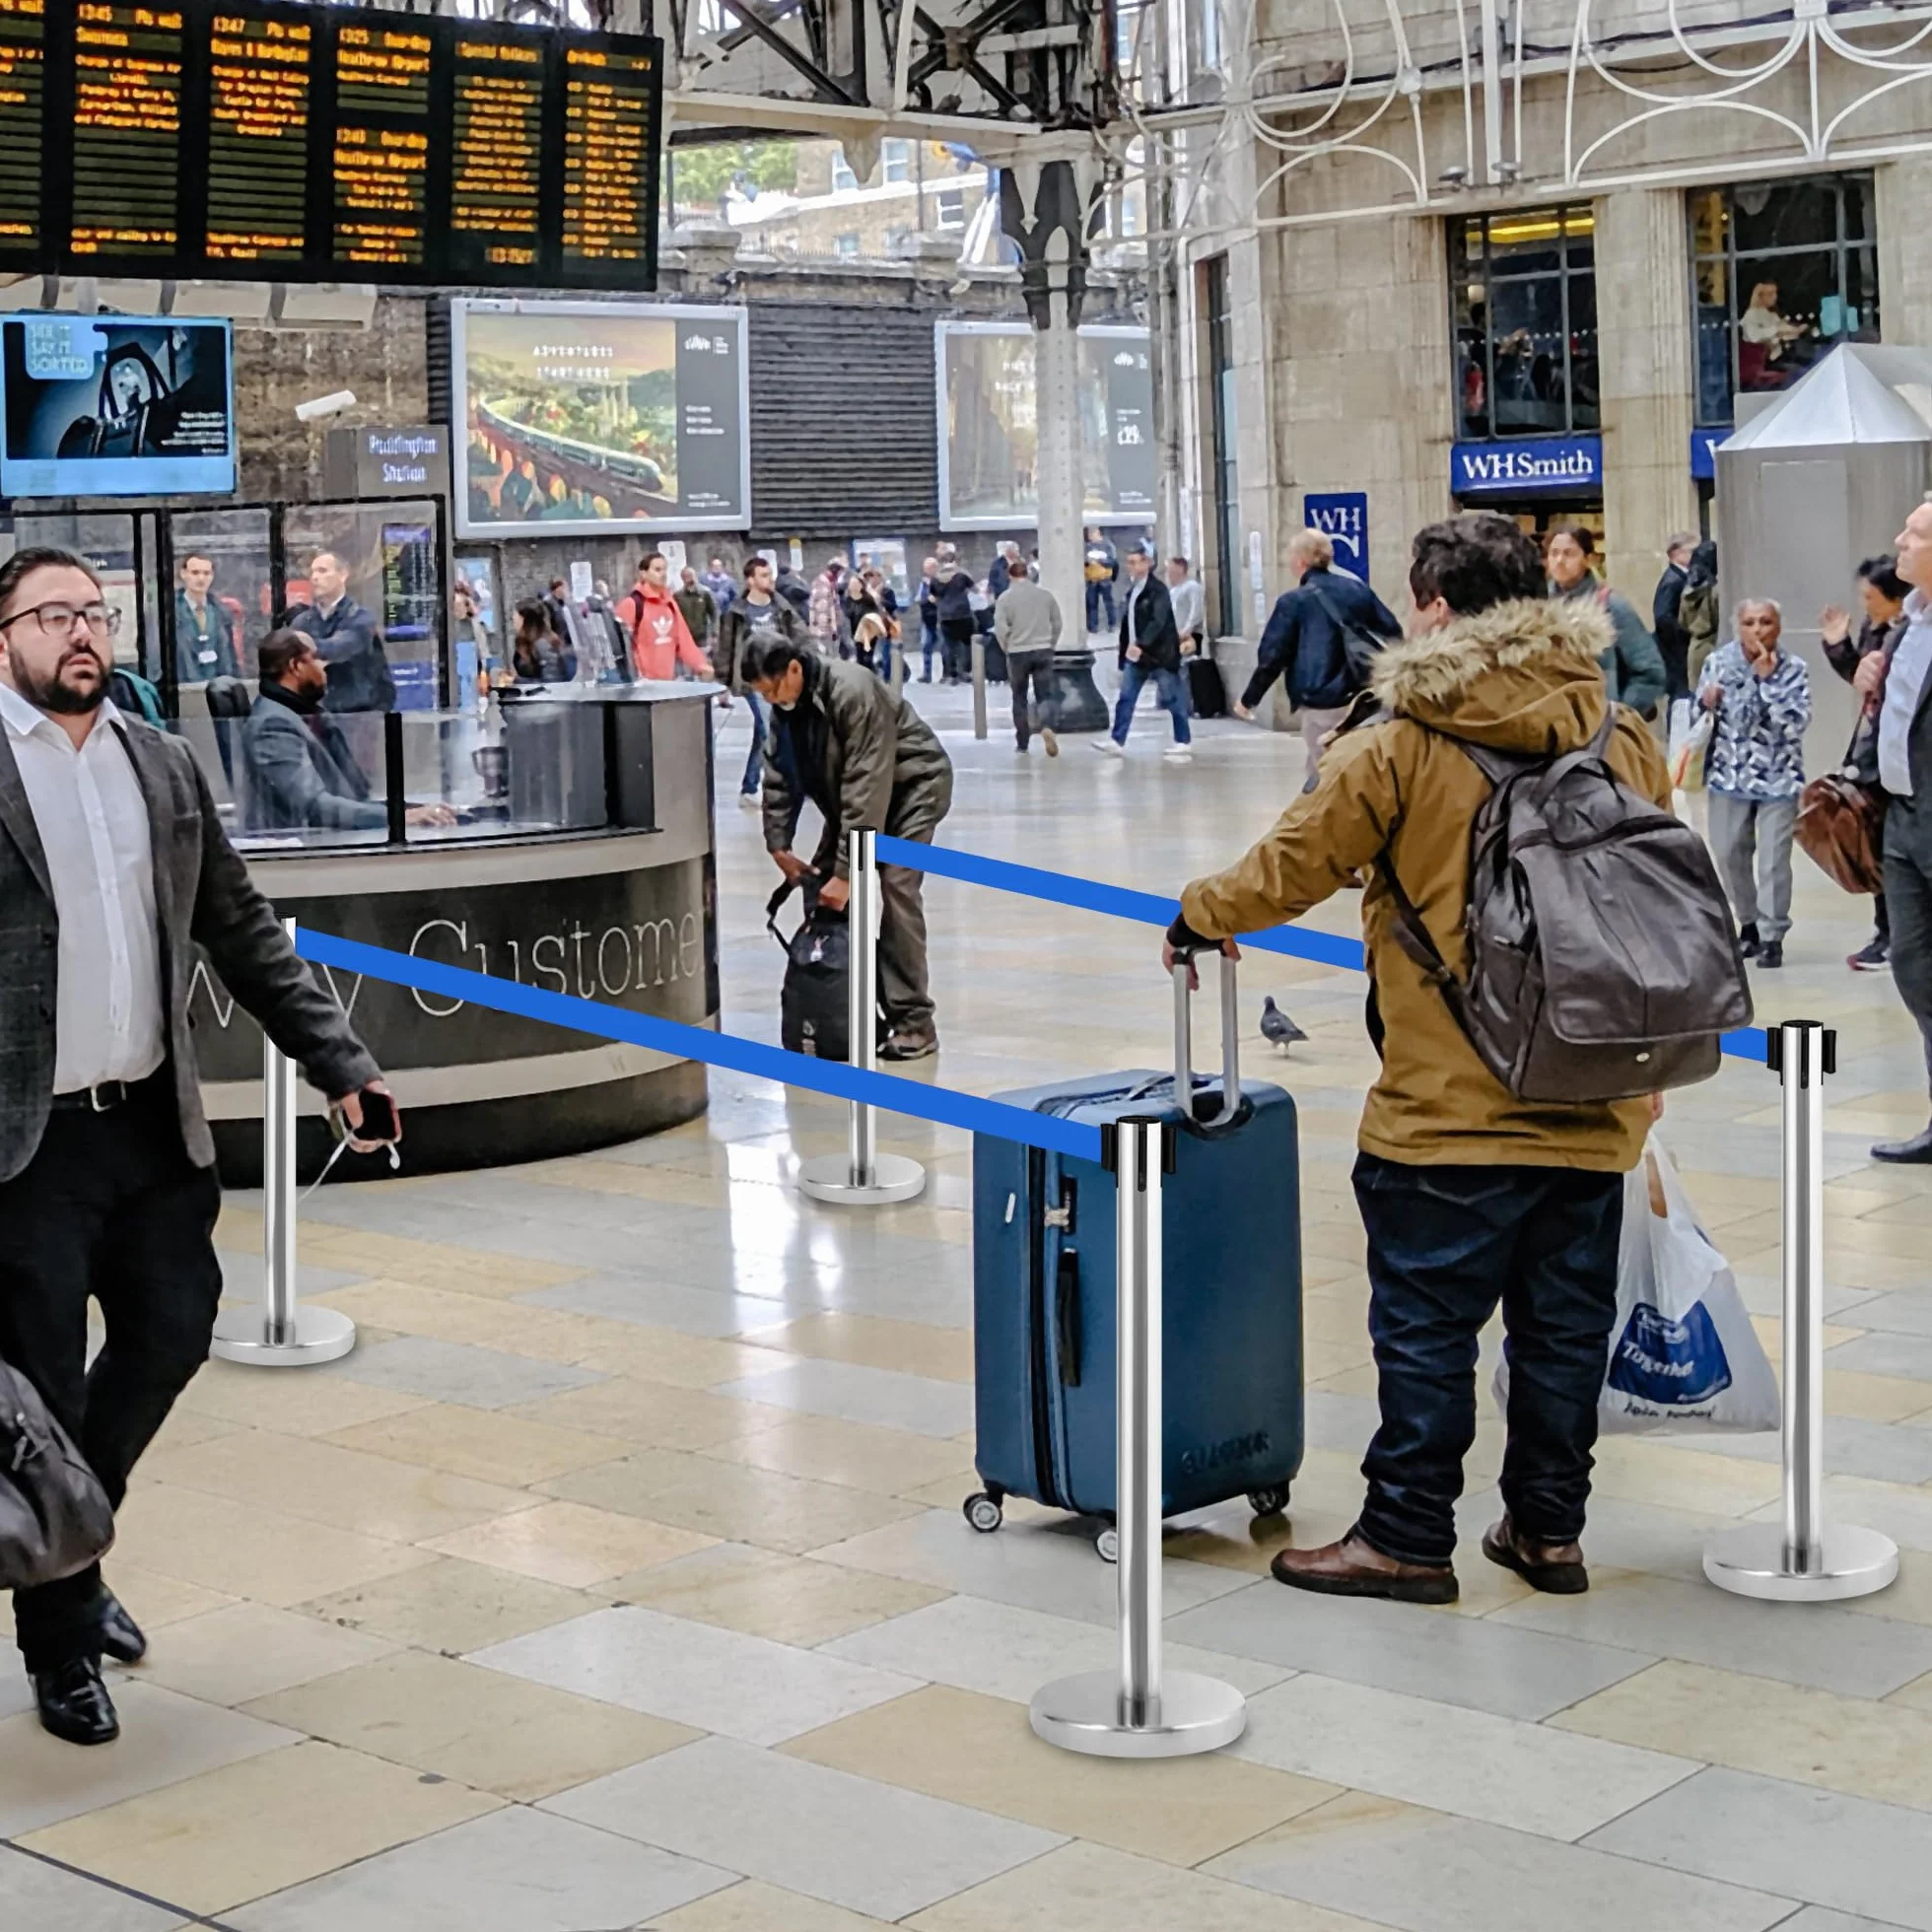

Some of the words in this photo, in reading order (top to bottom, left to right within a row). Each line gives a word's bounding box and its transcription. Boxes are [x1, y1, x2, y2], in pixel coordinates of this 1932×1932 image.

[1462, 448, 1594, 480] WHSmith
[1310, 506, 1361, 532] WH
[408, 909, 704, 1017] Custome
